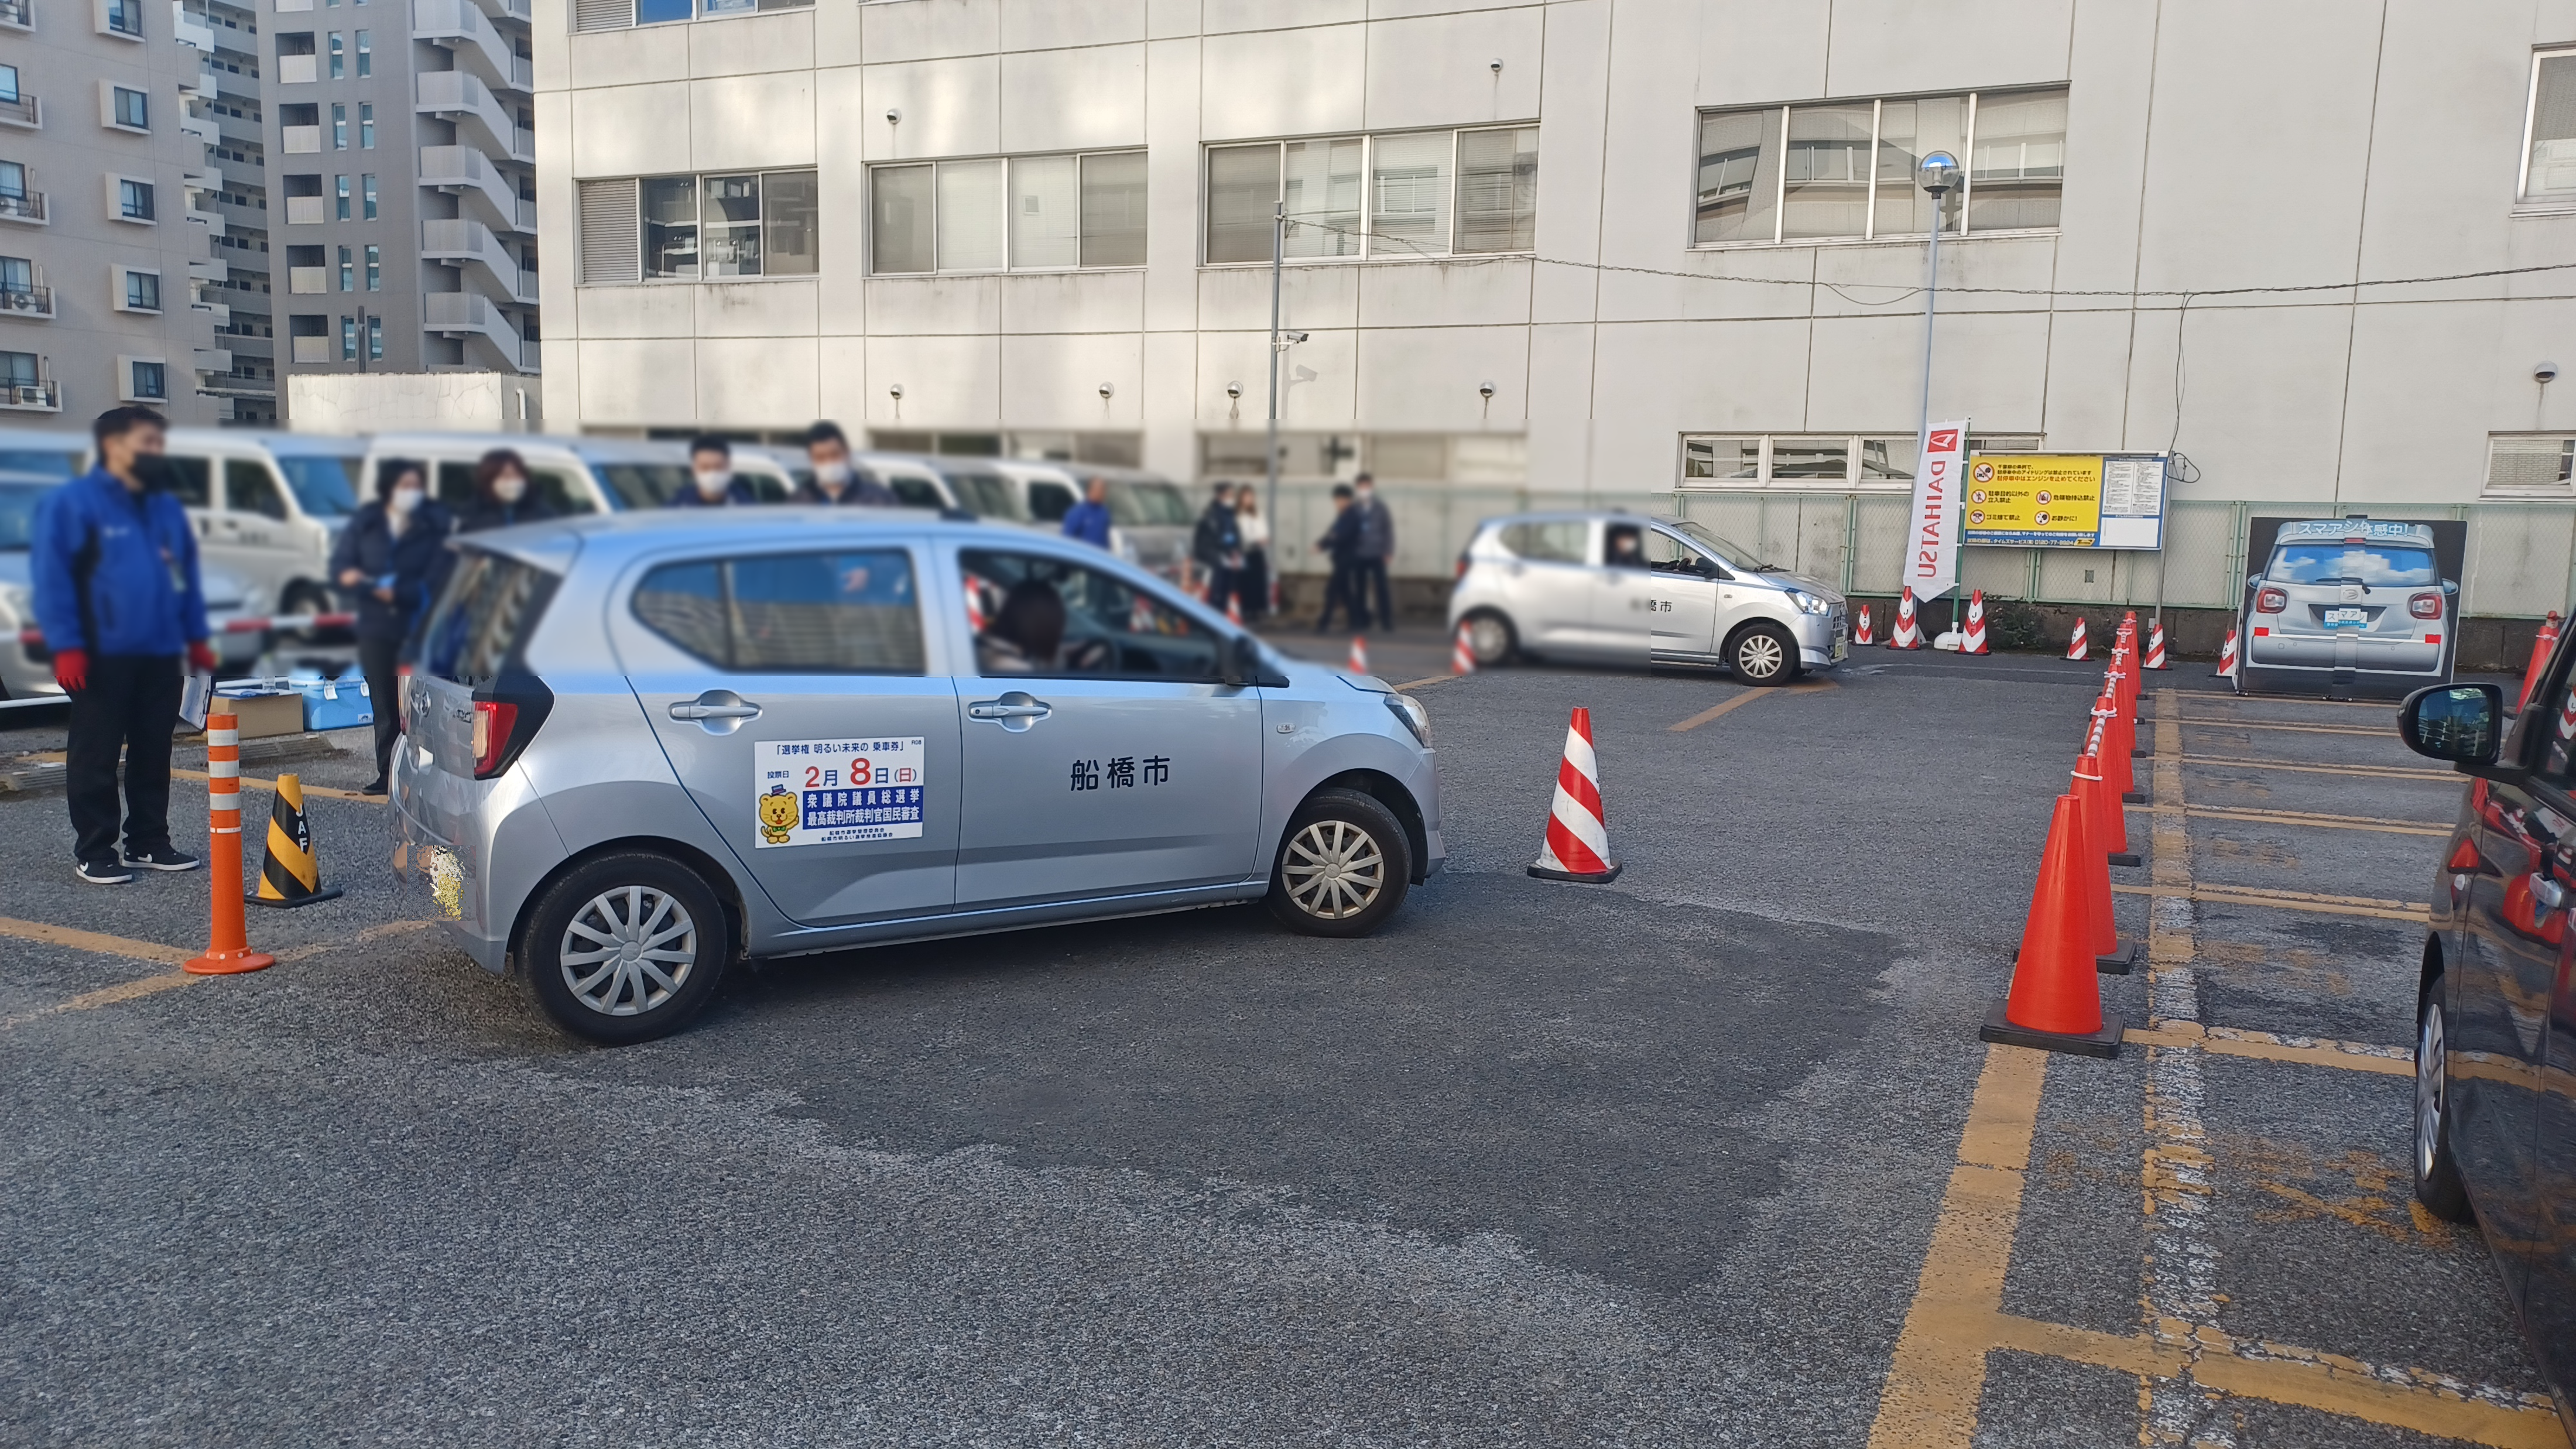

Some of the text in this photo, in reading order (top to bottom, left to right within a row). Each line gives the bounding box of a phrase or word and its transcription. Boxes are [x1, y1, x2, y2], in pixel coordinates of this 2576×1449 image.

[814, 742, 869, 754] 明るい未来の
[1070, 755, 1170, 792] 船橋市
[807, 788, 920, 809] 衆議院議員総選挙
[807, 806, 920, 827] 最高裁判所裁判官国民審査
[296, 803, 308, 852] JAF
